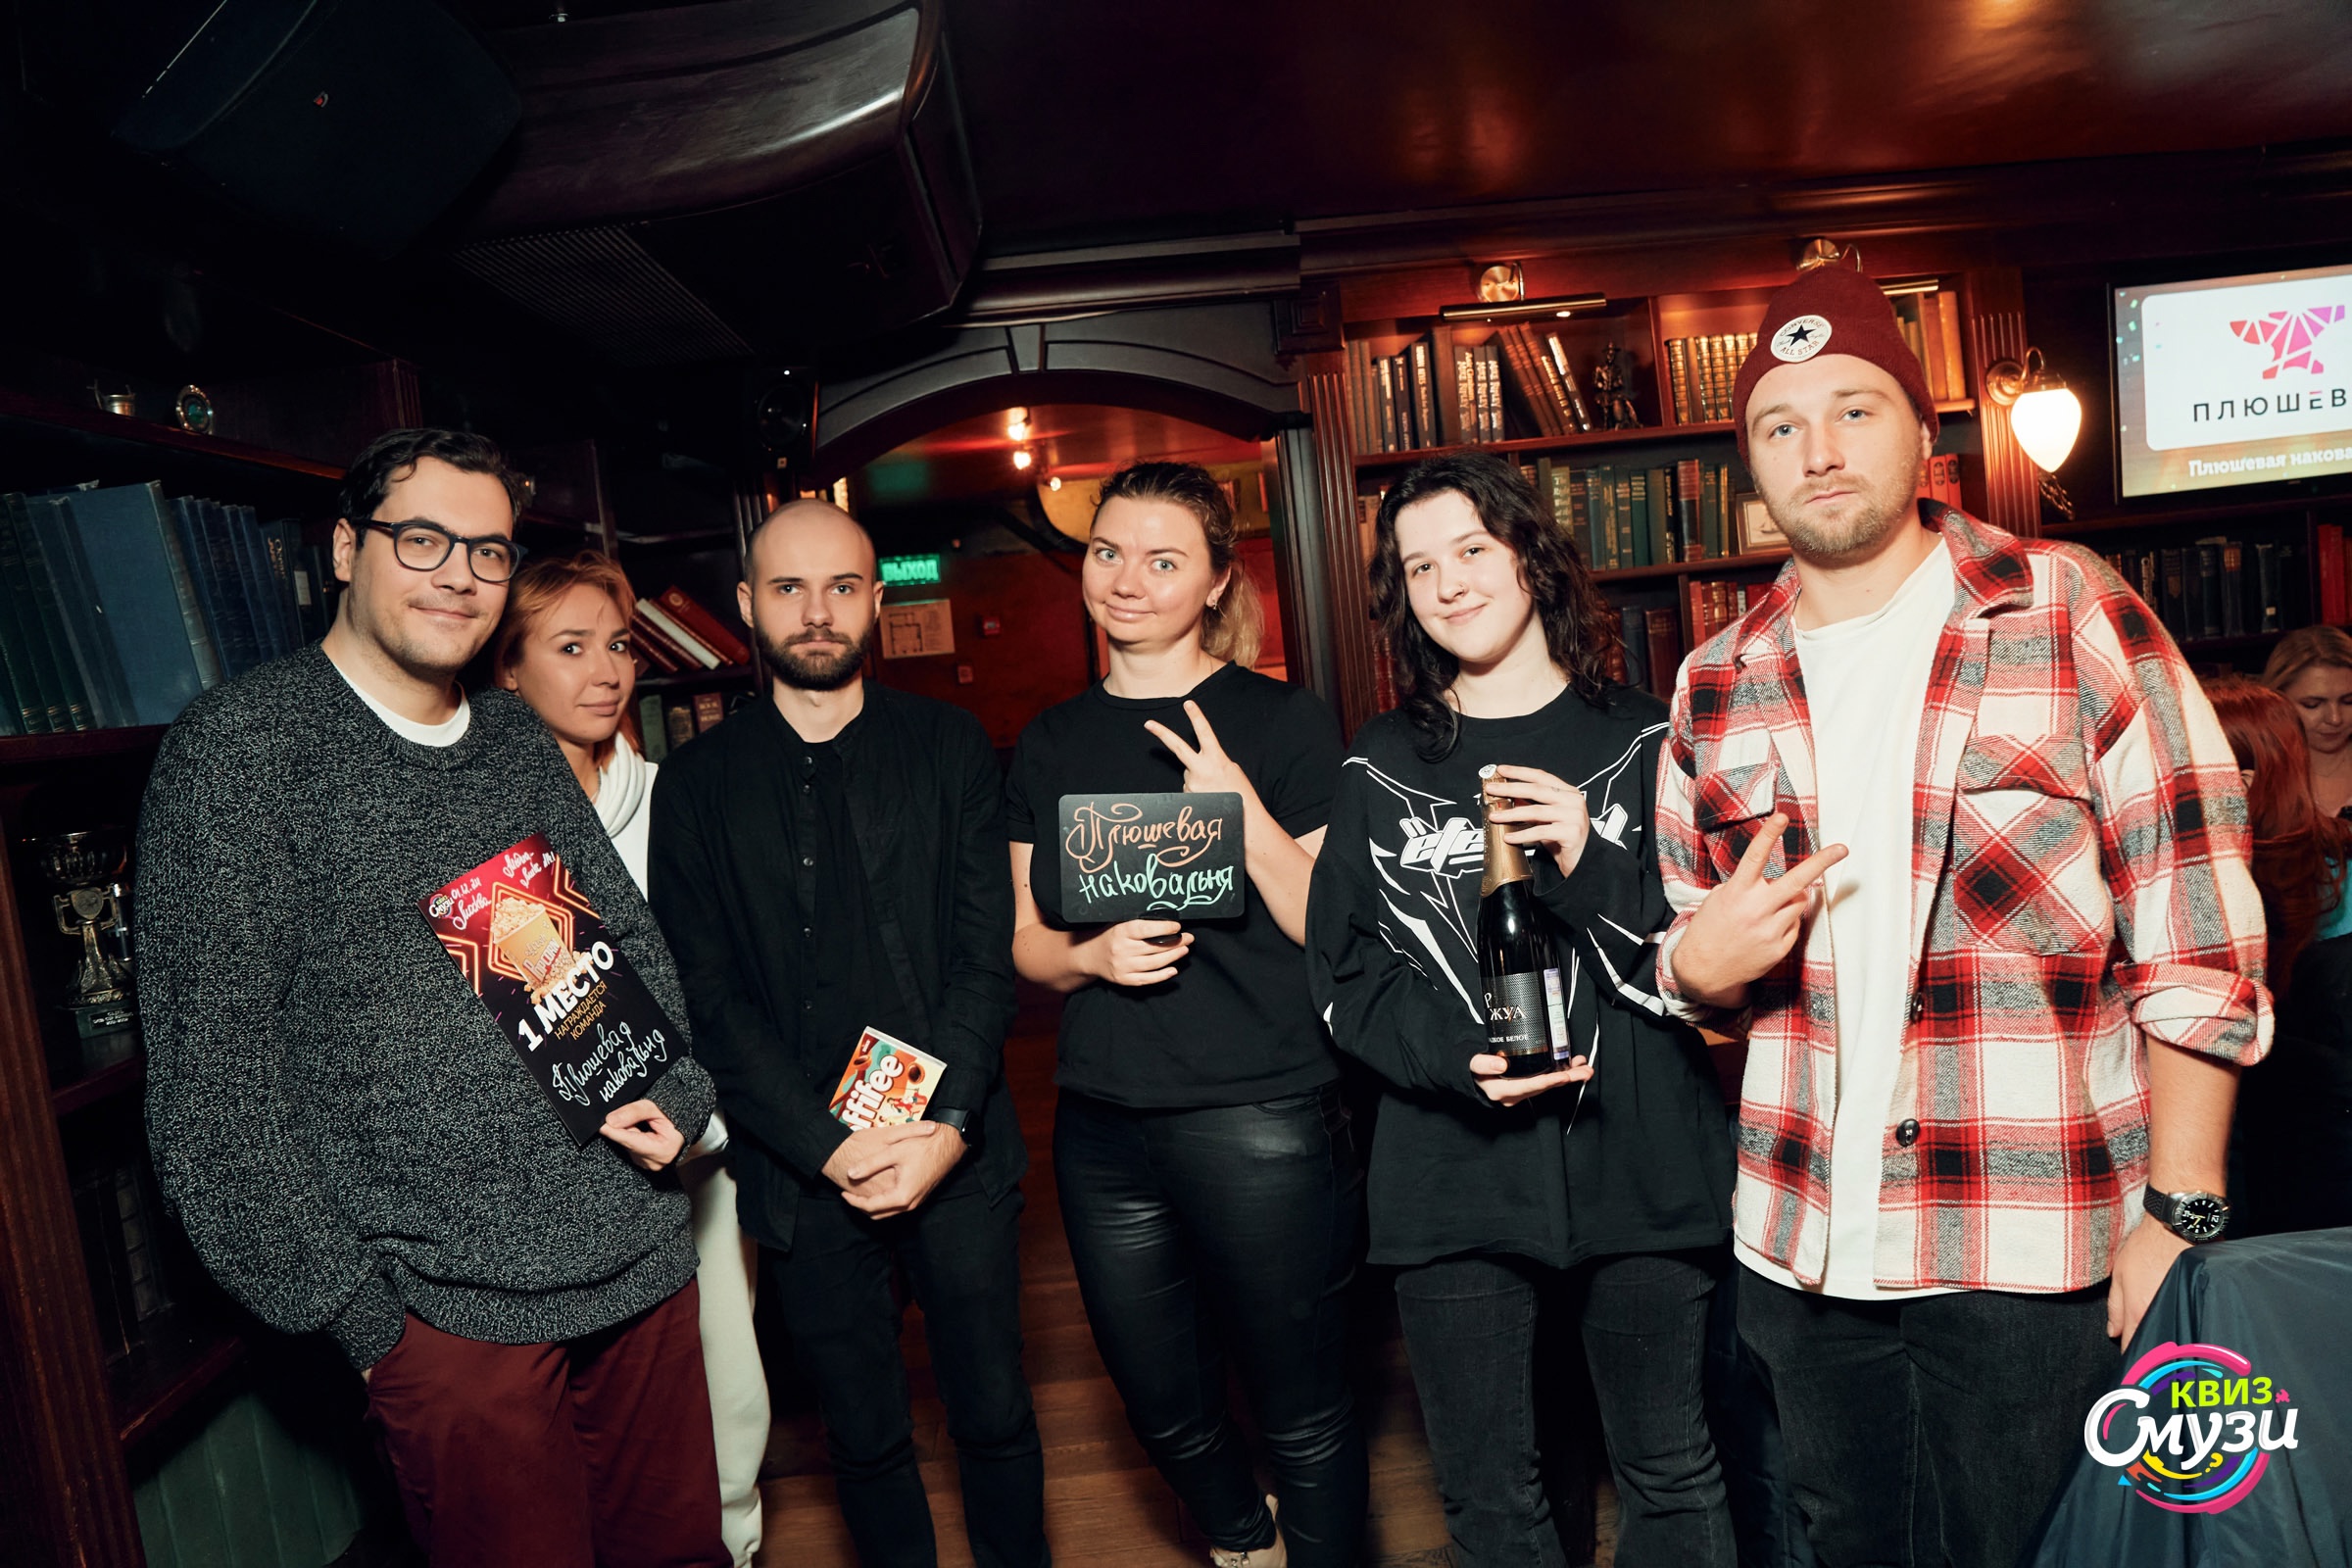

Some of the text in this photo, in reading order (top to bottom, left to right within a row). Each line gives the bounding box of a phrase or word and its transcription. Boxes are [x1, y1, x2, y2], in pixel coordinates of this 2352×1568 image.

[1780, 319, 1824, 337] CONVERSE
[1780, 346, 1794, 356] ALL
[1797, 341, 1820, 356] STAR
[2193, 388, 2347, 422] ПЛЮШЕВ
[2188, 446, 2352, 478] Плюшевая накова
[882, 559, 940, 582] ВЫХОД
[1065, 802, 1223, 874] Плюшевая
[451, 876, 482, 900] 01.12.24
[1079, 853, 1234, 911] наковальня
[428, 896, 455, 918] Смузи
[453, 893, 492, 930] Москва
[518, 1018, 544, 1052] 1
[533, 941, 614, 1034] МЕСТО
[554, 980, 608, 1040] НАГРАЖДАЕТСЯ
[569, 1001, 607, 1041] КОМАНДА
[552, 1021, 635, 1106] Плюшевая
[599, 1029, 667, 1102] наковальня
